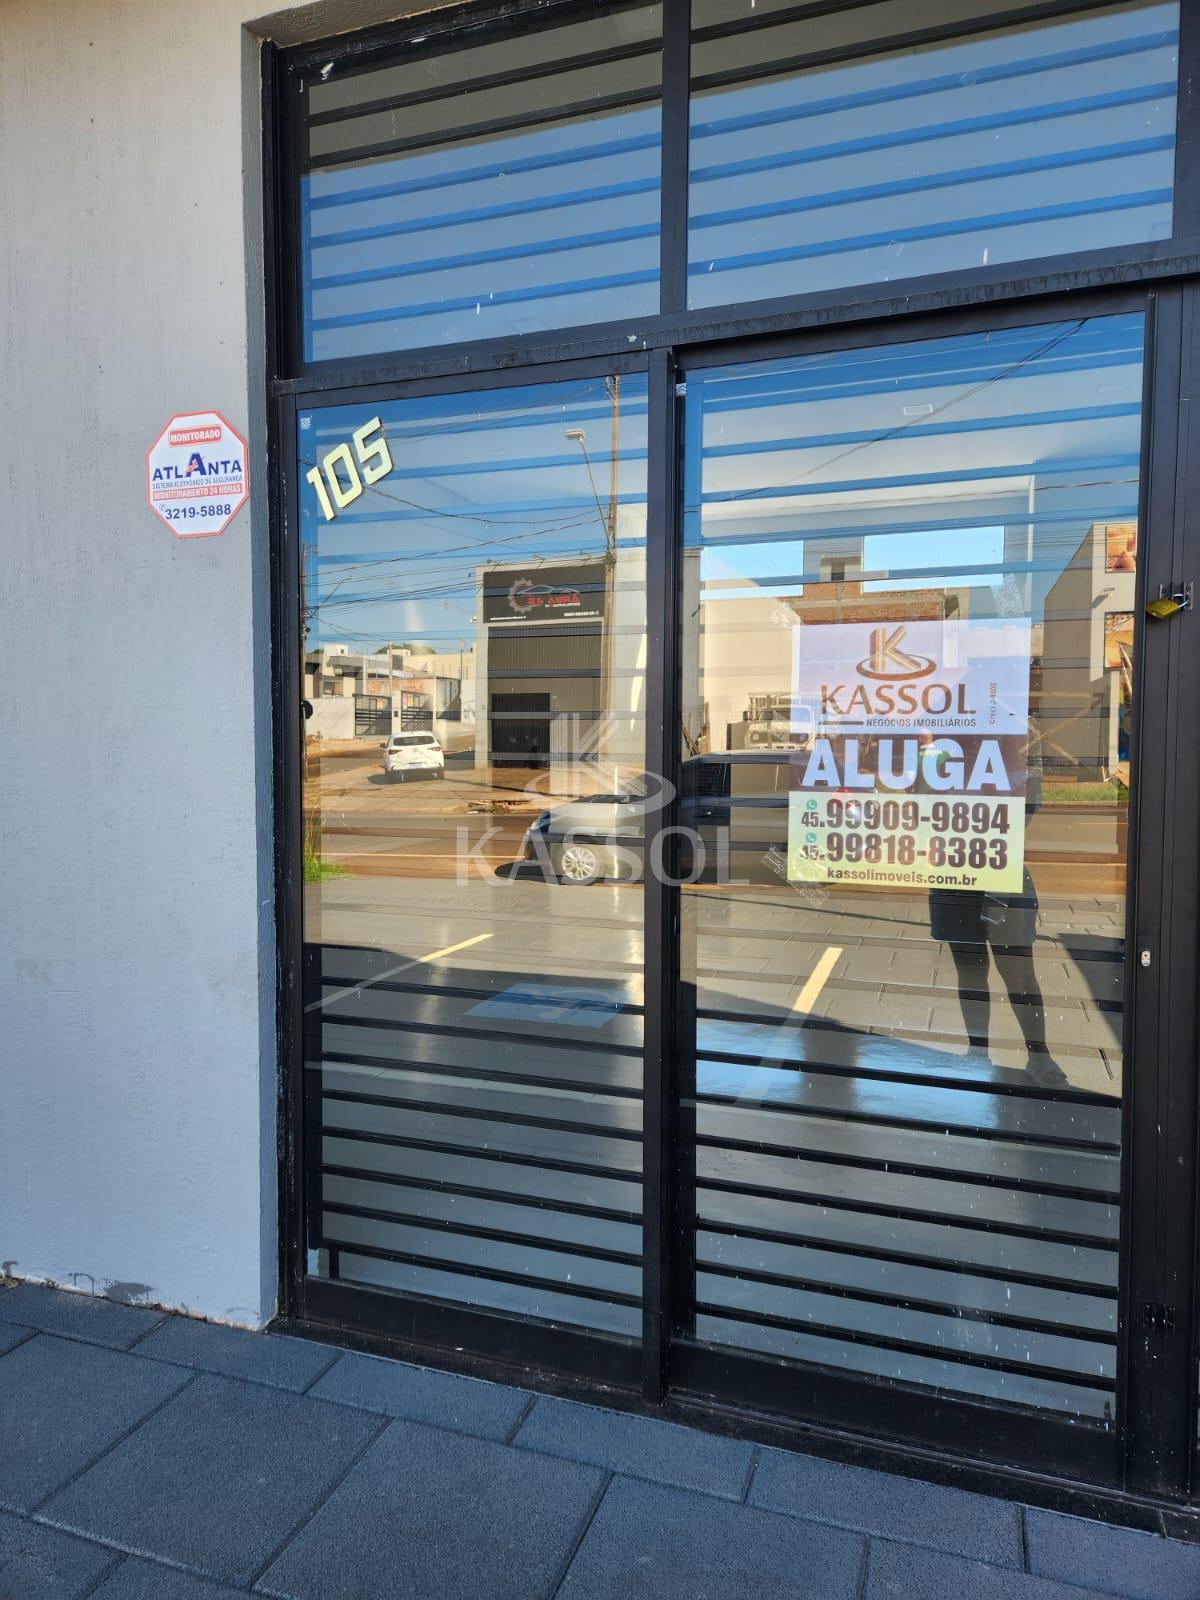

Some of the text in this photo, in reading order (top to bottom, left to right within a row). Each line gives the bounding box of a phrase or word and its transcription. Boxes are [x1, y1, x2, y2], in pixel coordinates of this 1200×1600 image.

[170, 429, 221, 443] MONITORADO
[152, 452, 242, 481] ATLANTA
[306, 416, 393, 521] 105
[153, 484, 241, 500] MONITORAMENTO 24 HORAS
[165, 503, 231, 520] 3219-5888
[821, 683, 976, 716] KASSOL
[866, 717, 976, 728] NEGÓCIOS IMOBILIÁRIOS
[801, 738, 1011, 791] ALUGA
[827, 867, 977, 887] kassolimoveis.com.br
